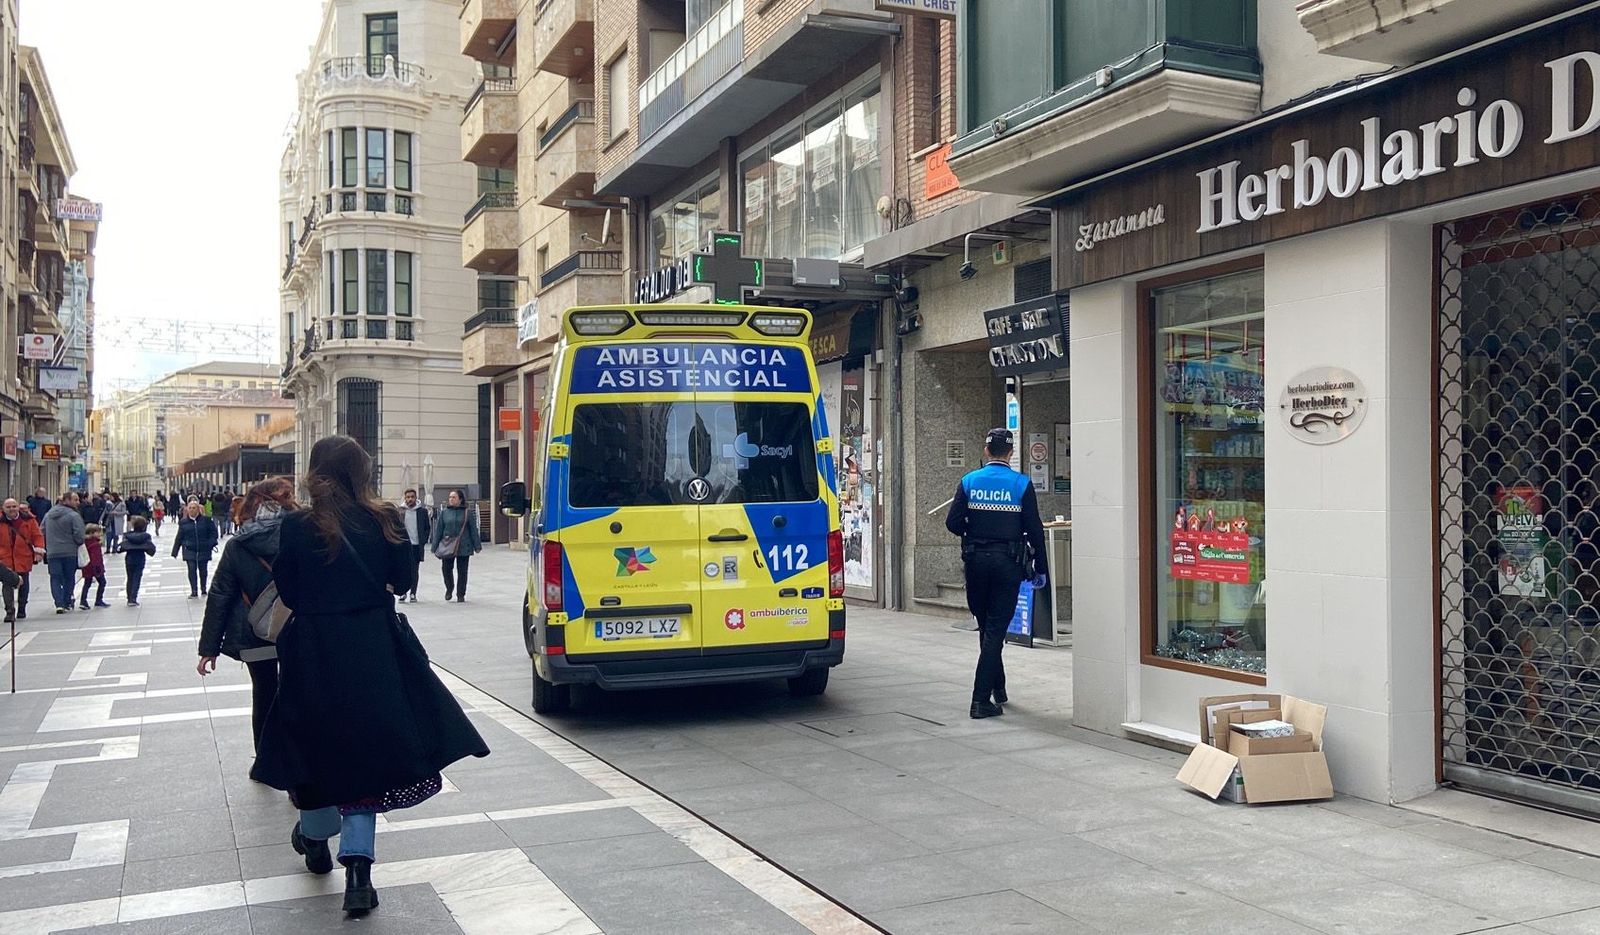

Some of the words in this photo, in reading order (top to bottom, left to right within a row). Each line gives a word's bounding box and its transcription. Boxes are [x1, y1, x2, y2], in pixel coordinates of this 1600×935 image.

[1195, 86, 1524, 233] Herbolario
[1075, 203, 1165, 251] Zarzamora
[596, 348, 787, 366] AMBULANCIA
[597, 369, 787, 388] ASISTENCIAL
[1287, 382, 1355, 394] herbolariodiez.com
[1292, 395, 1347, 409] HerboDiez
[760, 444, 793, 459] Sacyl
[970, 488, 1012, 502] POLICÍA
[768, 543, 809, 571] 112
[605, 620, 643, 635] 5092
[649, 618, 678, 634] LXZ
